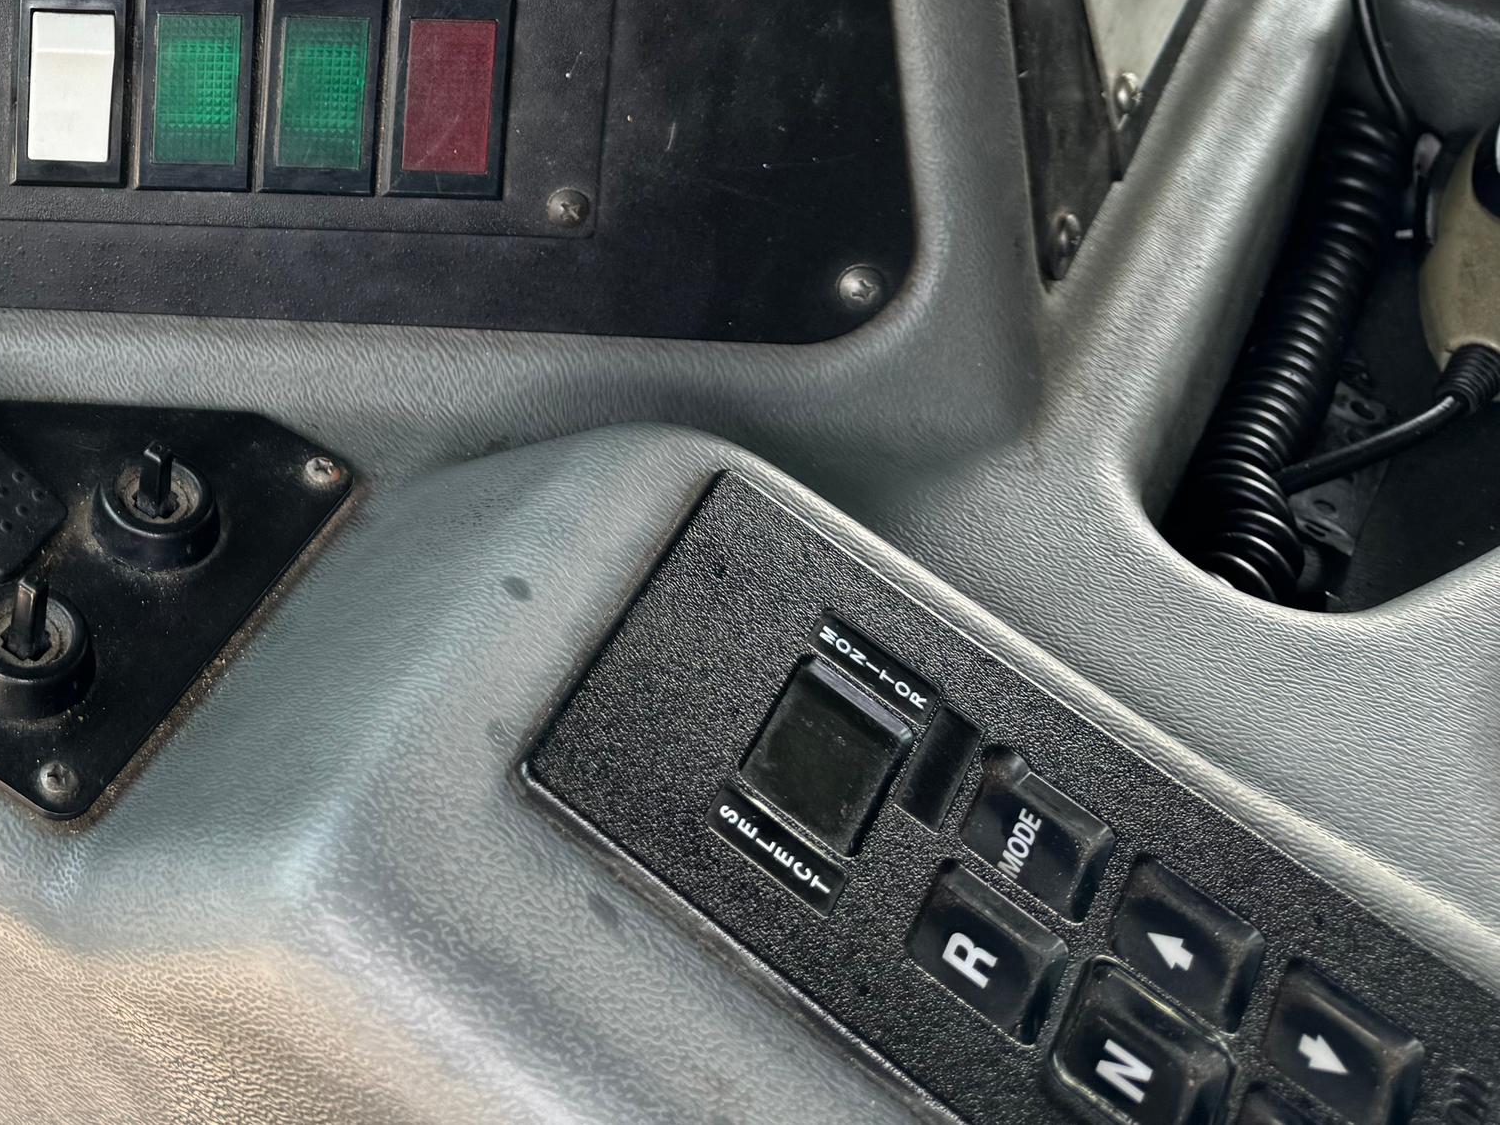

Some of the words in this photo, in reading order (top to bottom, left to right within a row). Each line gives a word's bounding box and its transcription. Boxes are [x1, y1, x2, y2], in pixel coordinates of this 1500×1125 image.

[819, 625, 927, 710] MONITOR
[719, 804, 831, 895] SELECT
[997, 807, 1043, 880] MODE
[941, 931, 998, 989] R
[1095, 1038, 1154, 1104] N
